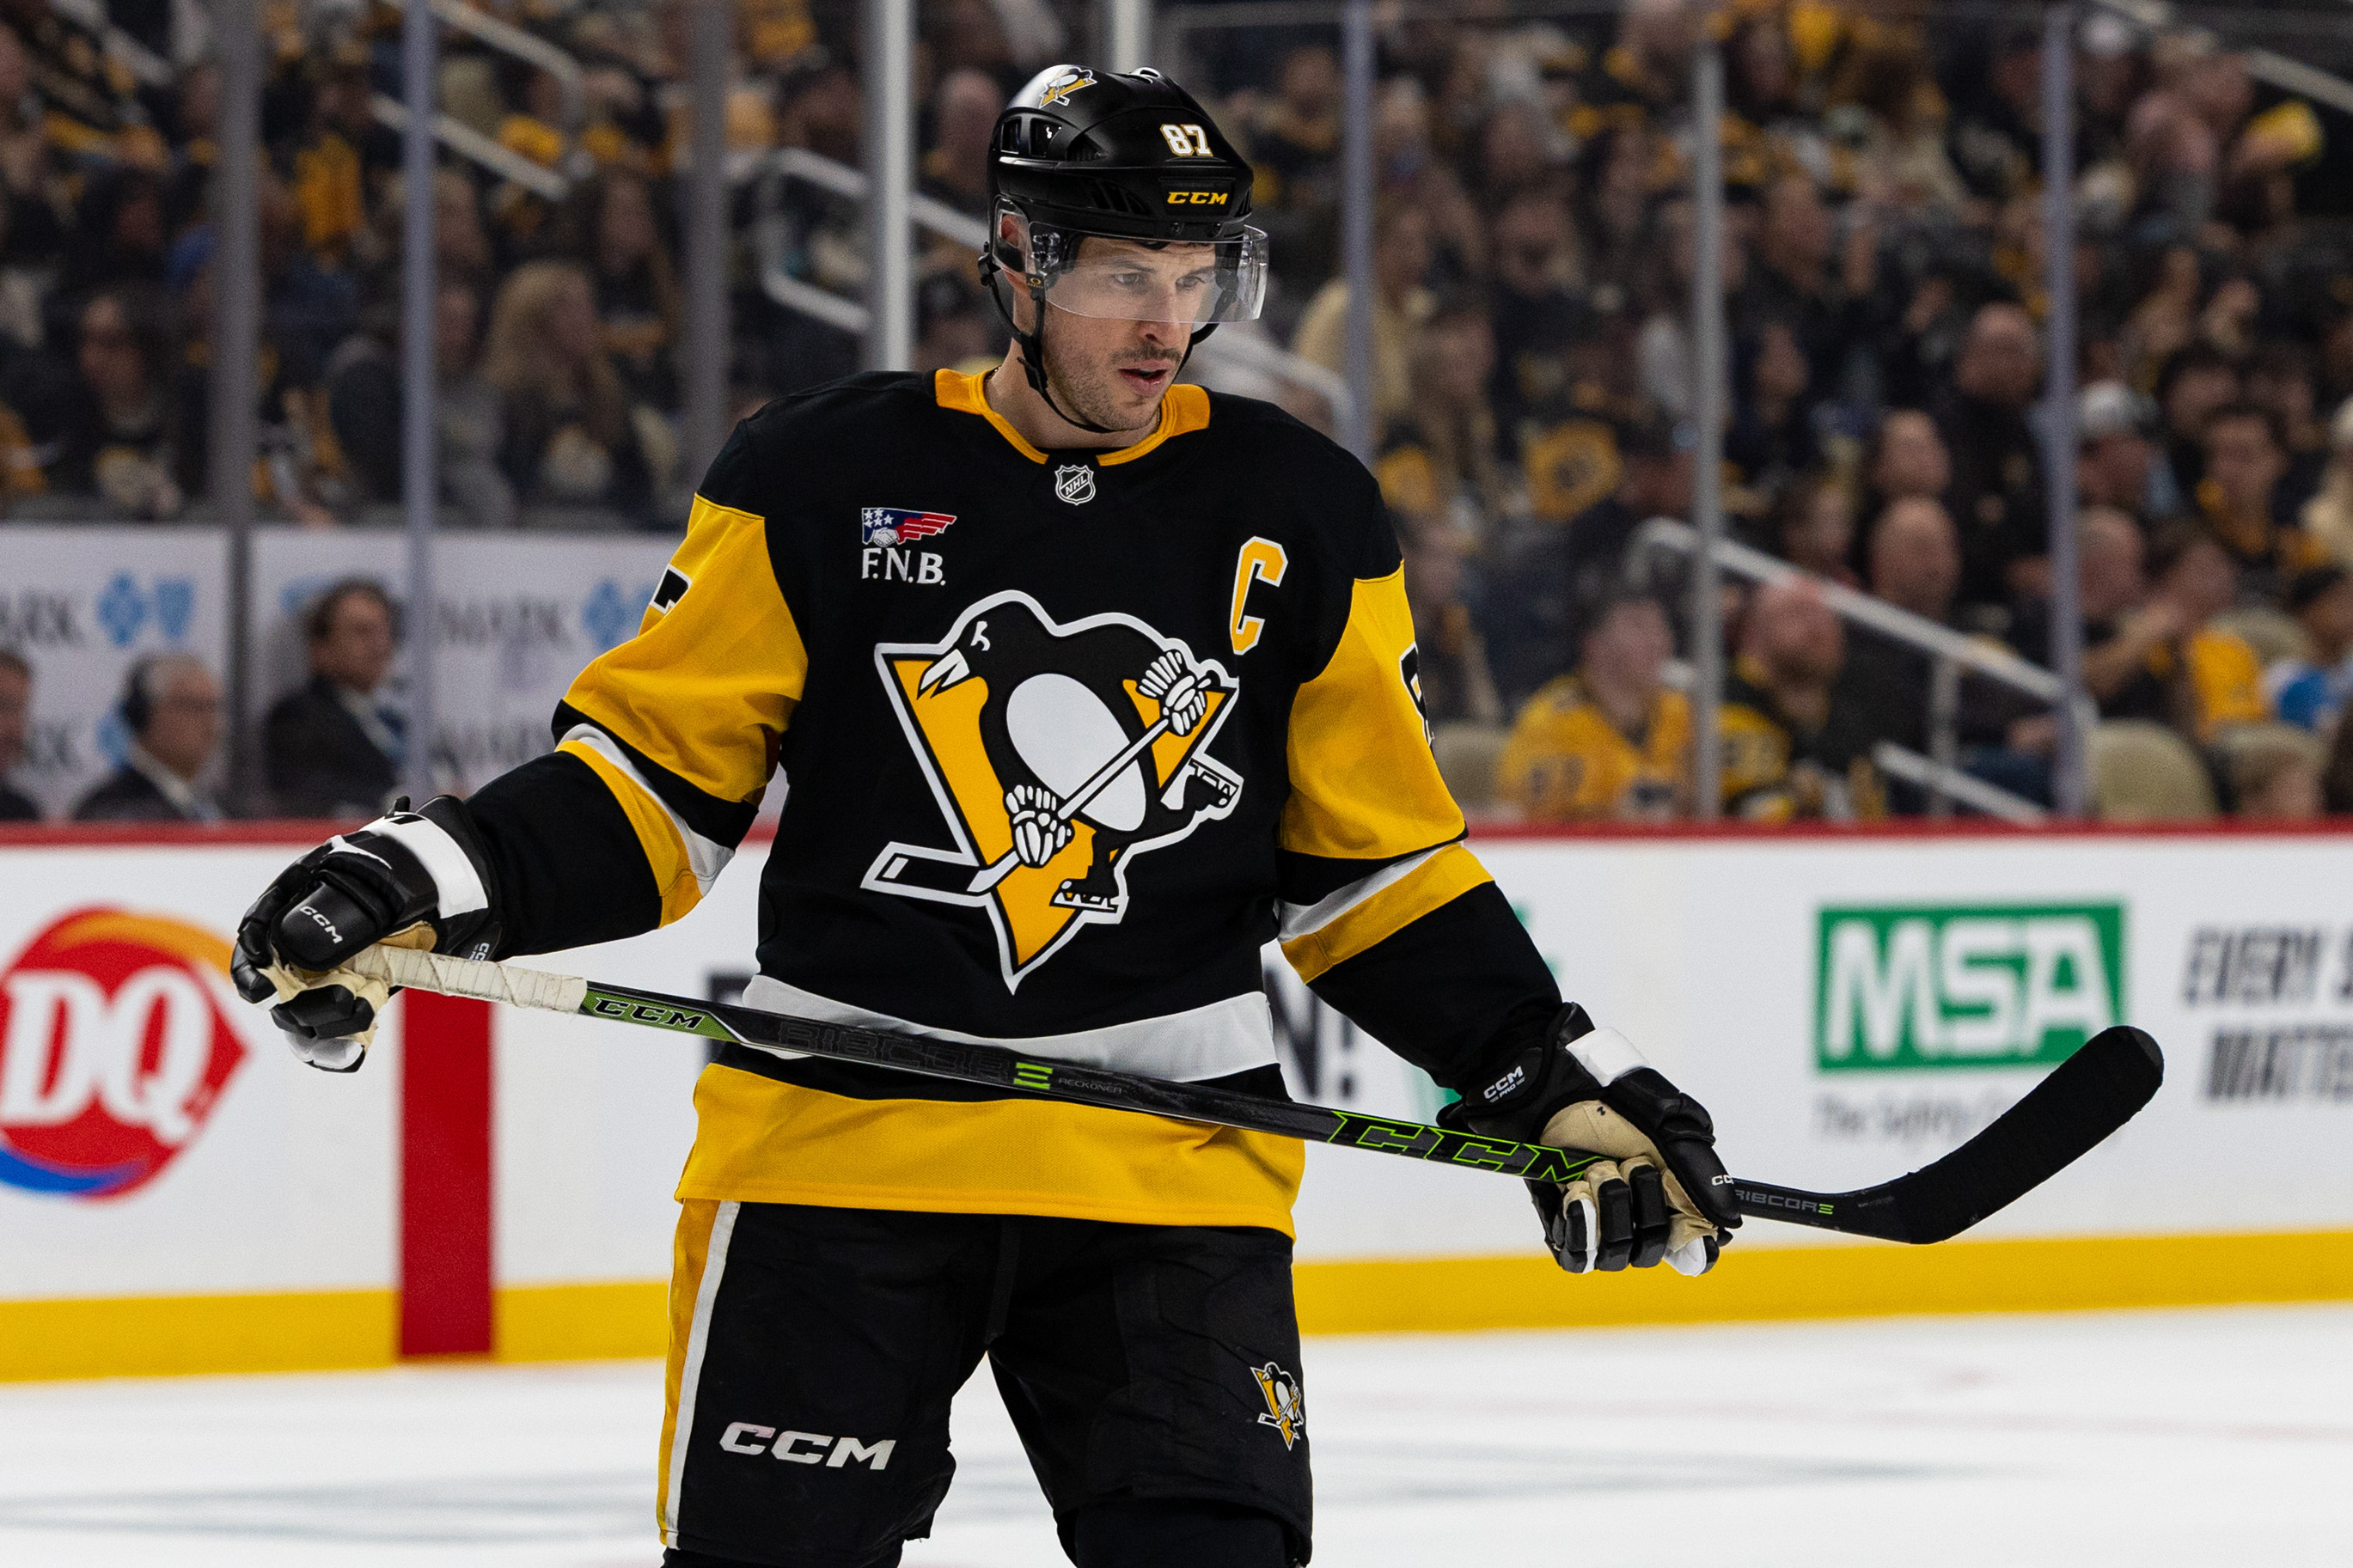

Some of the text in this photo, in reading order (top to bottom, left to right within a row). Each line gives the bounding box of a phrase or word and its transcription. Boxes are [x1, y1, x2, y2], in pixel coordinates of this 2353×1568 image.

[1160, 125, 1213, 156] 87
[1167, 192, 1228, 204] CCM
[1066, 475, 1087, 496] NHL
[862, 547, 946, 586] F.N.B.
[1230, 536, 1288, 655] C
[300, 906, 343, 944] CCM
[1822, 915, 2109, 1061] MSA
[593, 997, 705, 1030] CCM
[0, 967, 215, 1144] DQ
[1058, 1077, 1123, 1095] RECKONER
[1483, 1065, 1523, 1100] CCM
[1499, 1083, 1516, 1098] PRO
[1327, 1111, 1605, 1182] CCM
[1734, 1188, 1834, 1215] RIBCORE
[719, 1420, 896, 1471] CCM
